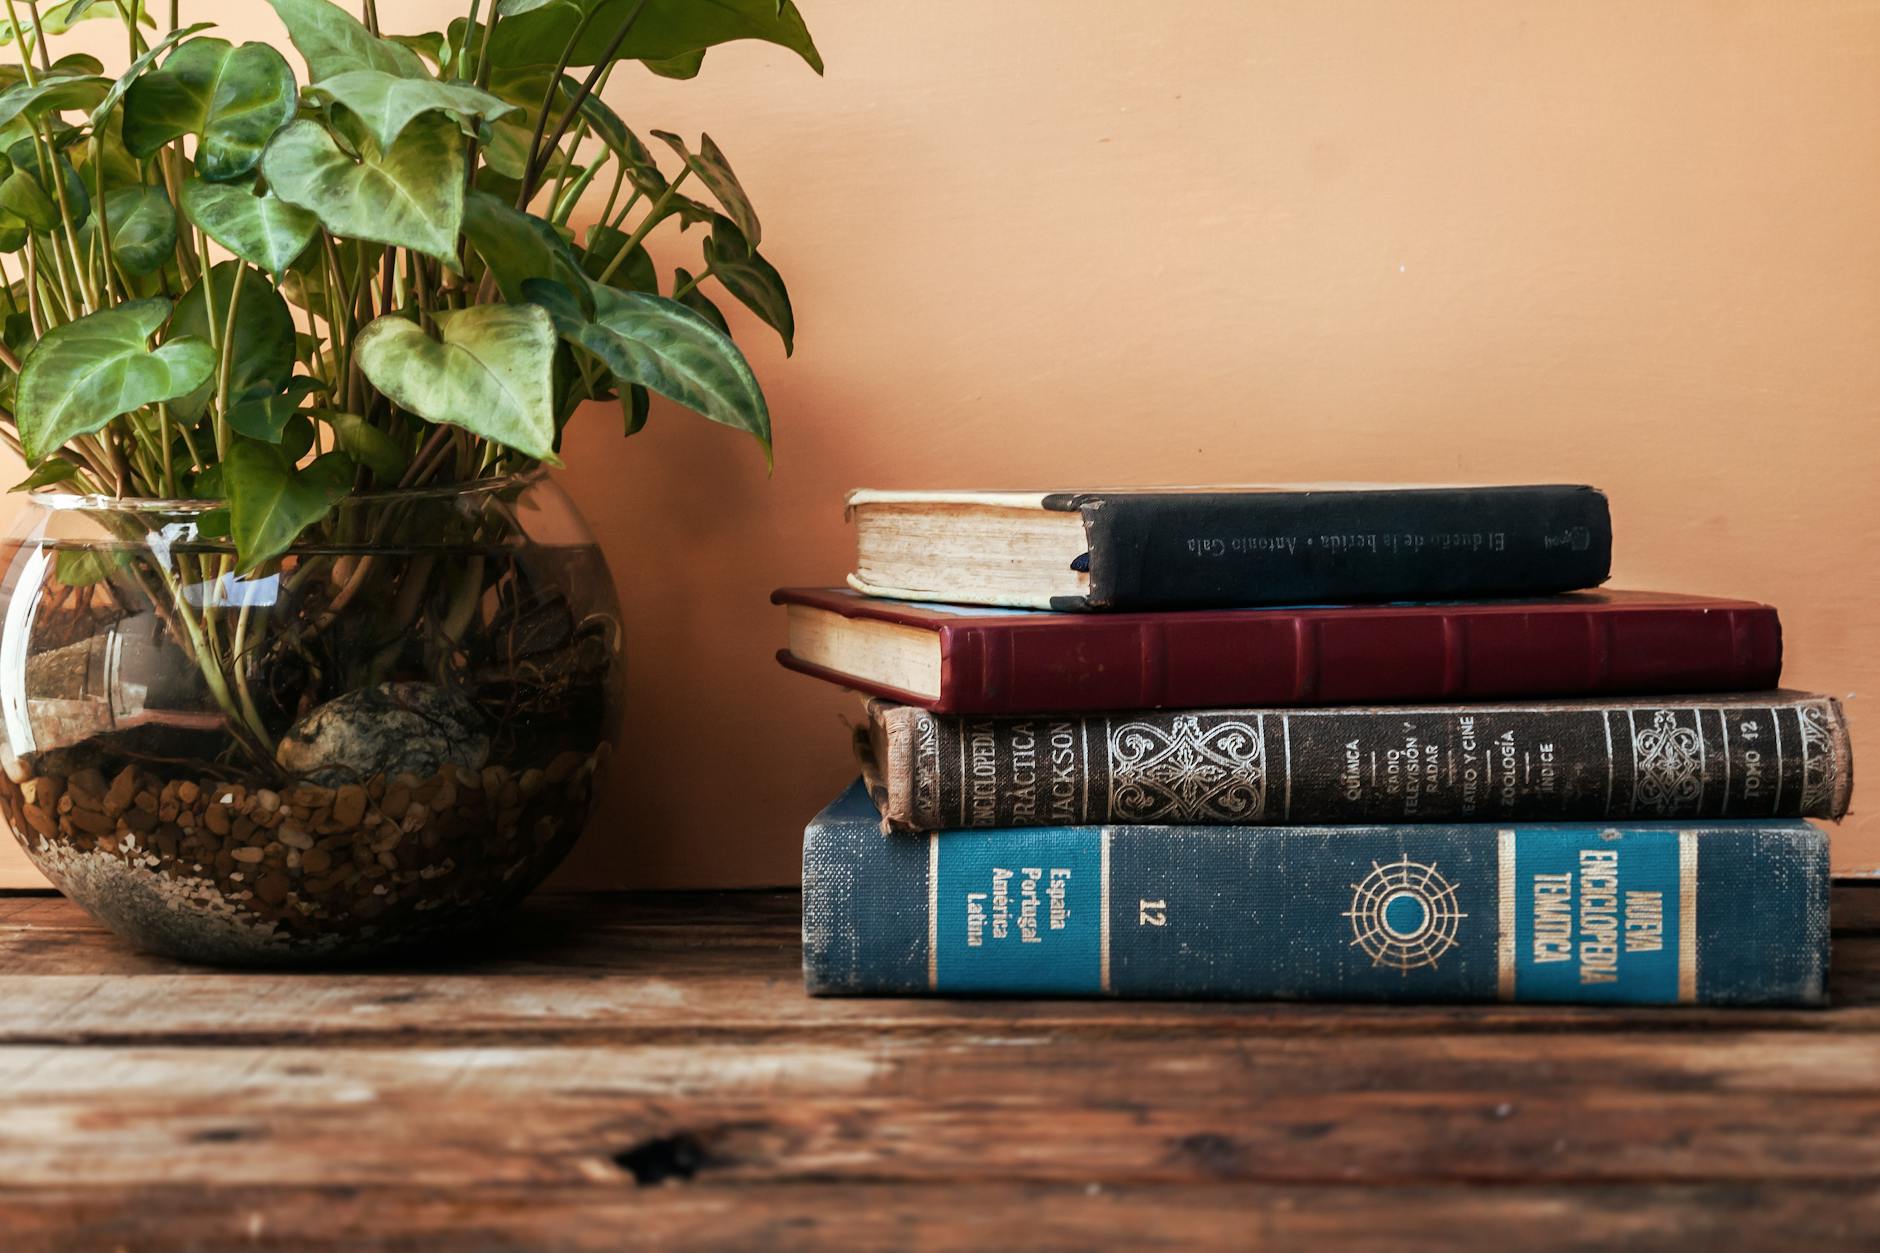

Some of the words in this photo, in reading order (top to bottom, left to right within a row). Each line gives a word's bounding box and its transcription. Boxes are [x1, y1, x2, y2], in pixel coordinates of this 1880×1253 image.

[1187, 538, 1225, 557] Gala
[1231, 537, 1297, 556] Antonio
[1320, 534, 1377, 553] herida
[1383, 533, 1397, 553] la
[1404, 533, 1424, 552] de
[1489, 532, 1505, 551] El
[1403, 721, 1416, 734] Y
[1460, 716, 1477, 750] CINE
[1741, 721, 1759, 740] 12
[972, 721, 996, 825] ENCICLOPEDIA
[1049, 722, 1075, 823] JACKSON
[1346, 739, 1361, 801] QUÍMICA
[1387, 749, 1400, 794] RADIO
[1401, 737, 1419, 815] TELEVISIÓN
[1426, 745, 1439, 793] RADAR
[1464, 753, 1477, 764] Y
[1494, 730, 1516, 806] ZOOLOGÍA
[1744, 751, 1761, 800] TOMO
[967, 893, 988, 946] Latina
[992, 868, 1014, 938] América
[1017, 868, 1042, 943] Portugal
[1046, 868, 1071, 930] España
[1140, 899, 1167, 926] 12
[1533, 872, 1572, 963] TEMATICA
[1579, 850, 1618, 984] ENCICLOPEDIA
[1625, 891, 1663, 952] NUEVA
